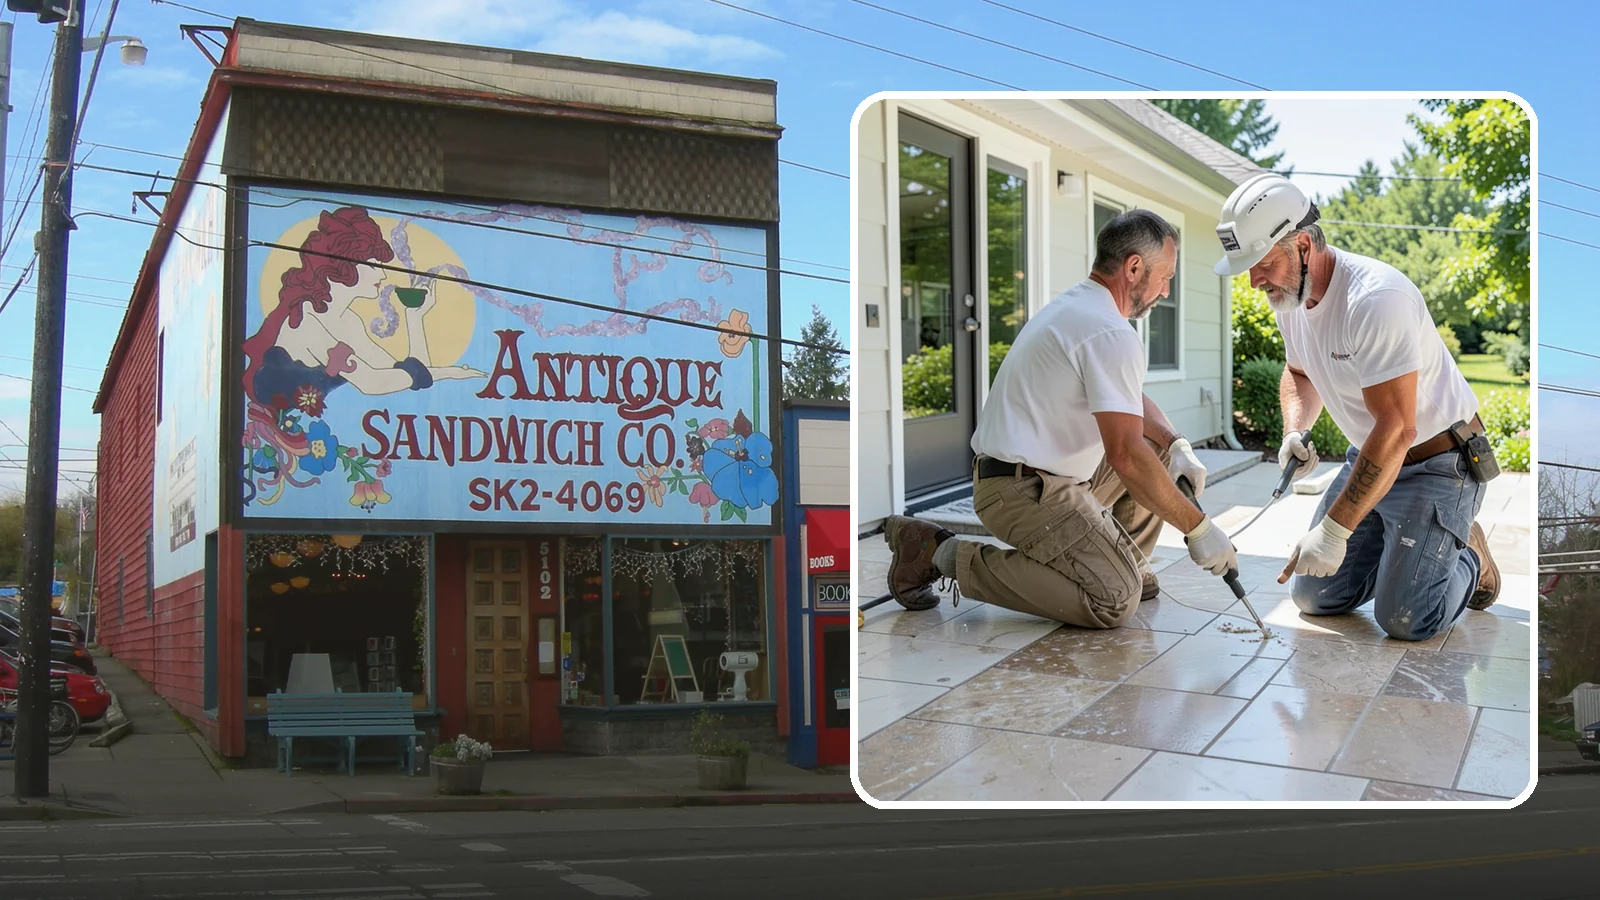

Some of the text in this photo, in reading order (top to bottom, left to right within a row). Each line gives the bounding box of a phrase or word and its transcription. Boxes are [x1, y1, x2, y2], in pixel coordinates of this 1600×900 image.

[476, 330, 723, 420] ANTIQUE
[362, 409, 686, 469] SANDWICH CO.
[469, 477, 646, 513] SK2-4069
[540, 542, 552, 599] 5102
[809, 555, 835, 568] BOOKS
